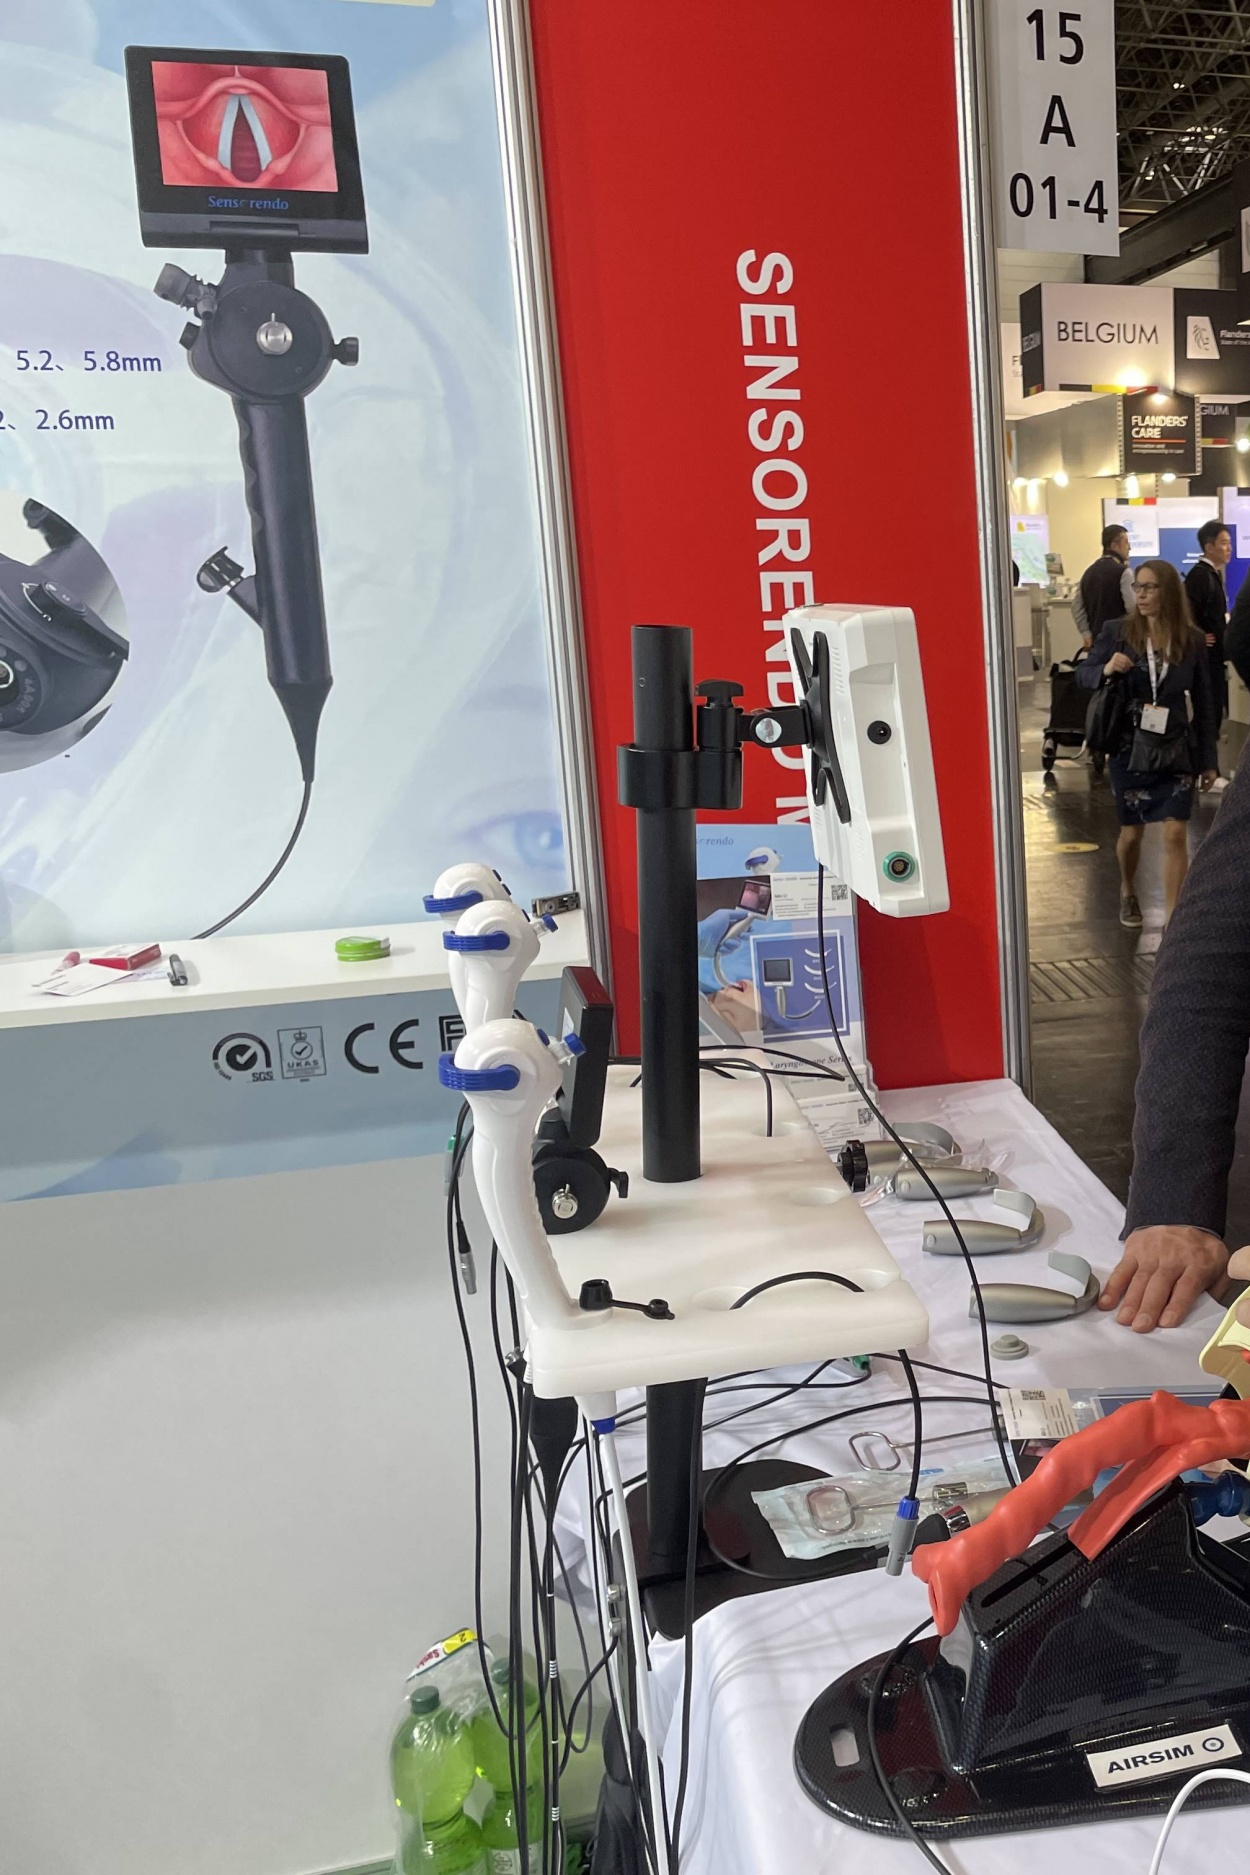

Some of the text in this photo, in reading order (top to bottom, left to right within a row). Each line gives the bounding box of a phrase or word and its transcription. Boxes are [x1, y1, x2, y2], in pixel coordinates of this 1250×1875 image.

[1026, 9, 1084, 65] 15
[1040, 94, 1076, 148] A
[1009, 172, 1109, 224] 01-4
[1057, 320, 1159, 345] BELGIUM
[84, 350, 162, 372] 5.8mm
[35, 409, 115, 430] 2.6mm
[1131, 428, 1161, 438] CARE
[736, 249, 815, 771] SENSORE
[344, 1018, 424, 1074] CE
[252, 1071, 274, 1082] SGS
[287, 1059, 320, 1069] UKAS
[1107, 1744, 1195, 1774] AIRSIM
